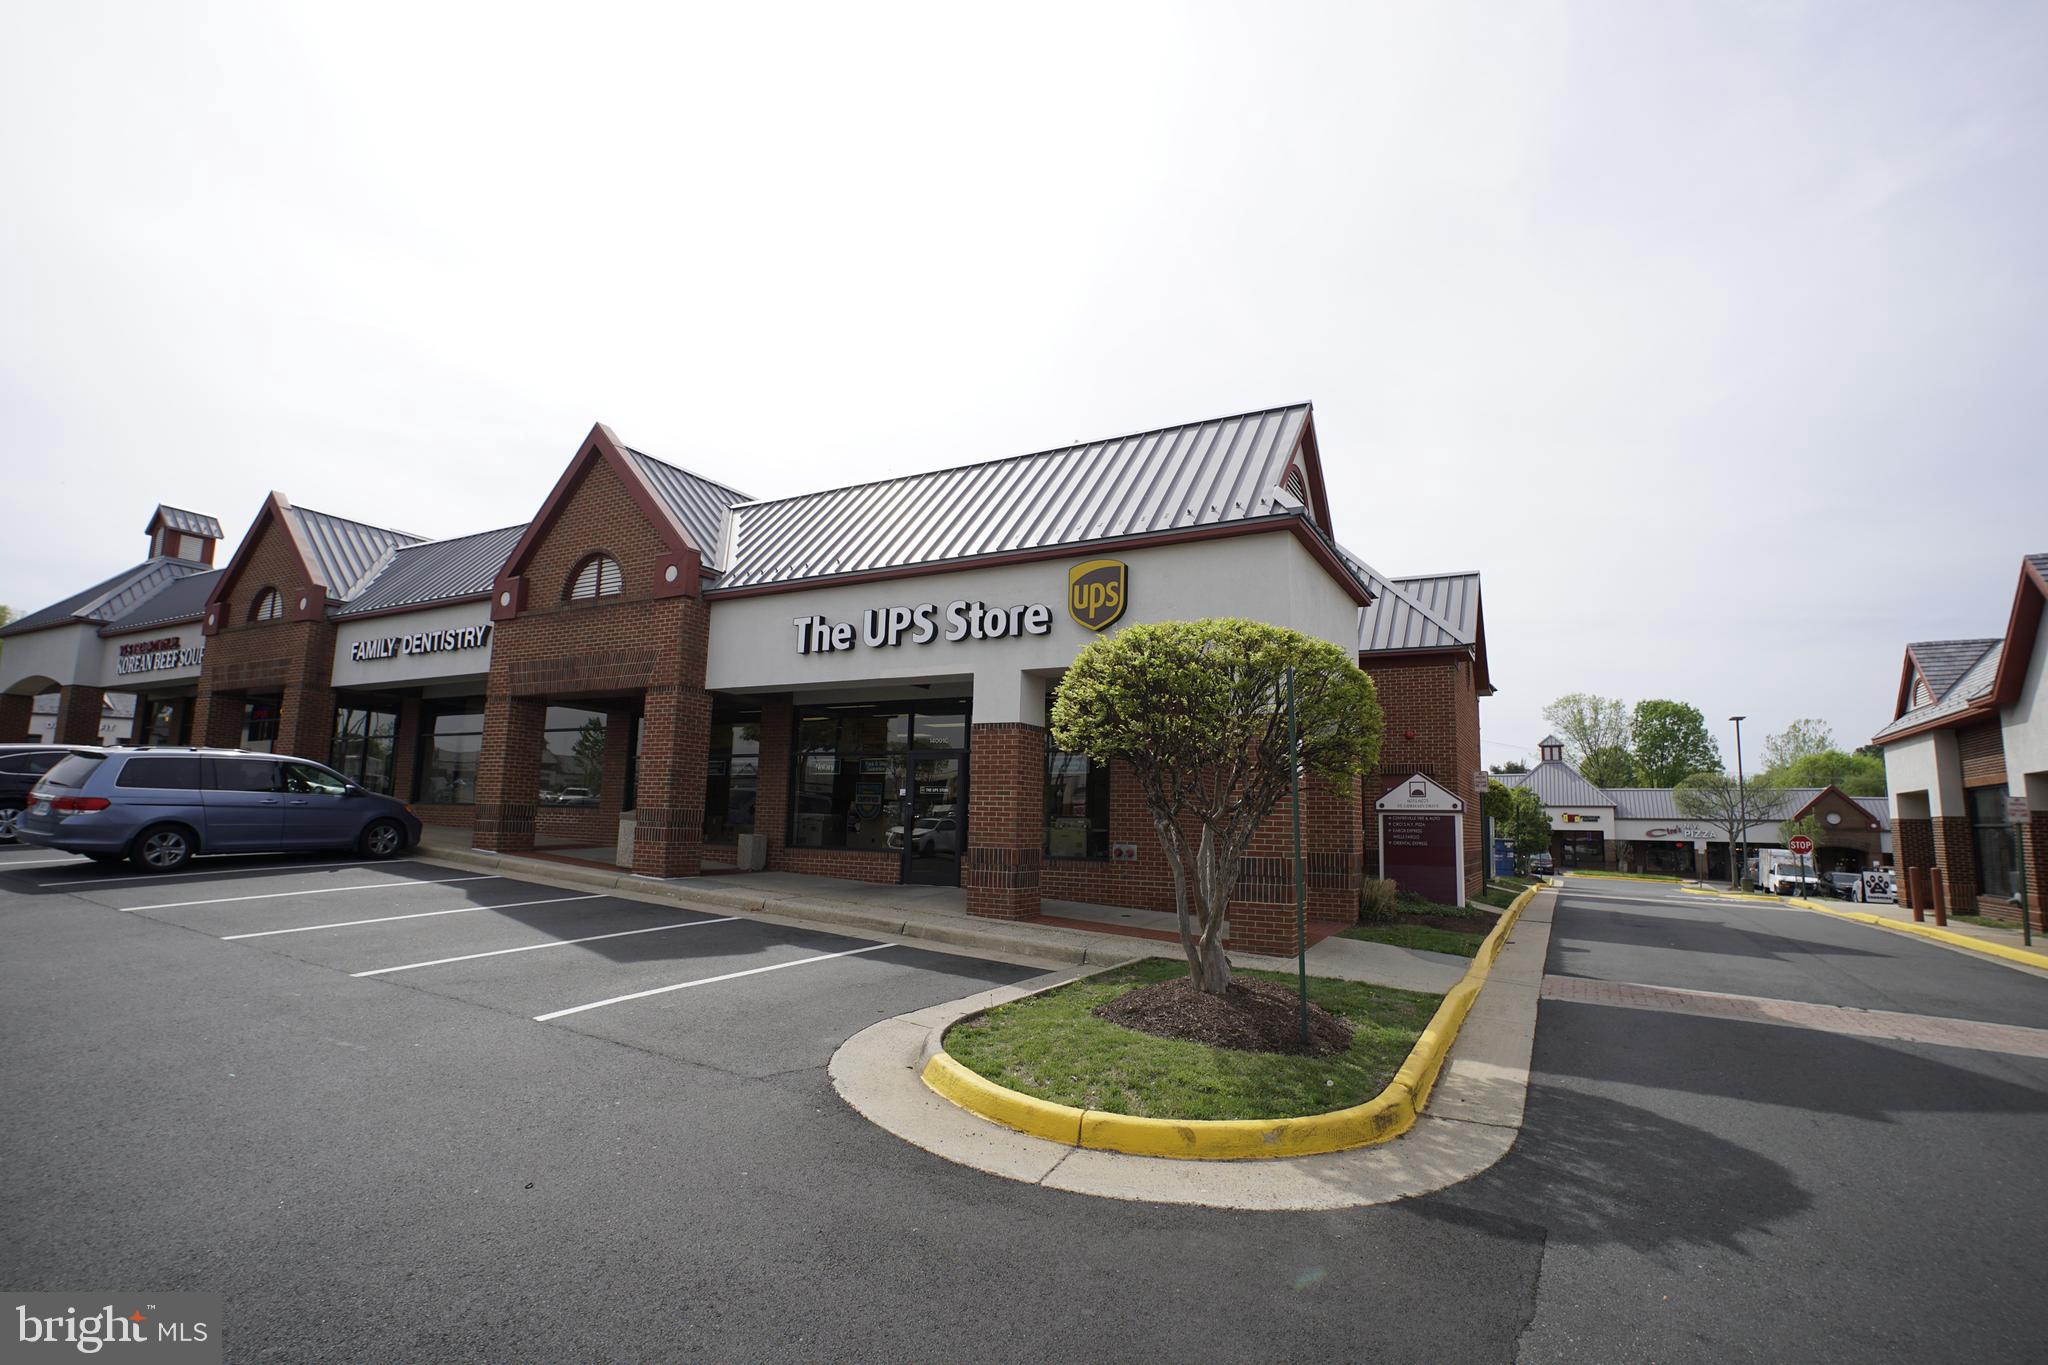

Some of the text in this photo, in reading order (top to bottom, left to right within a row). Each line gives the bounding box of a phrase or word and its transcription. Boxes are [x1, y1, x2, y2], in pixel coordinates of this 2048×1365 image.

[1073, 580, 1120, 619] ups
[351, 625, 489, 661] FAMILY DENTISTRY
[793, 600, 1053, 655] The UPS Store
[116, 653, 155, 675] KOREAN
[154, 649, 180, 670] BEEF
[1684, 830, 1718, 840] PIZZA
[1790, 840, 1811, 849] STOP
